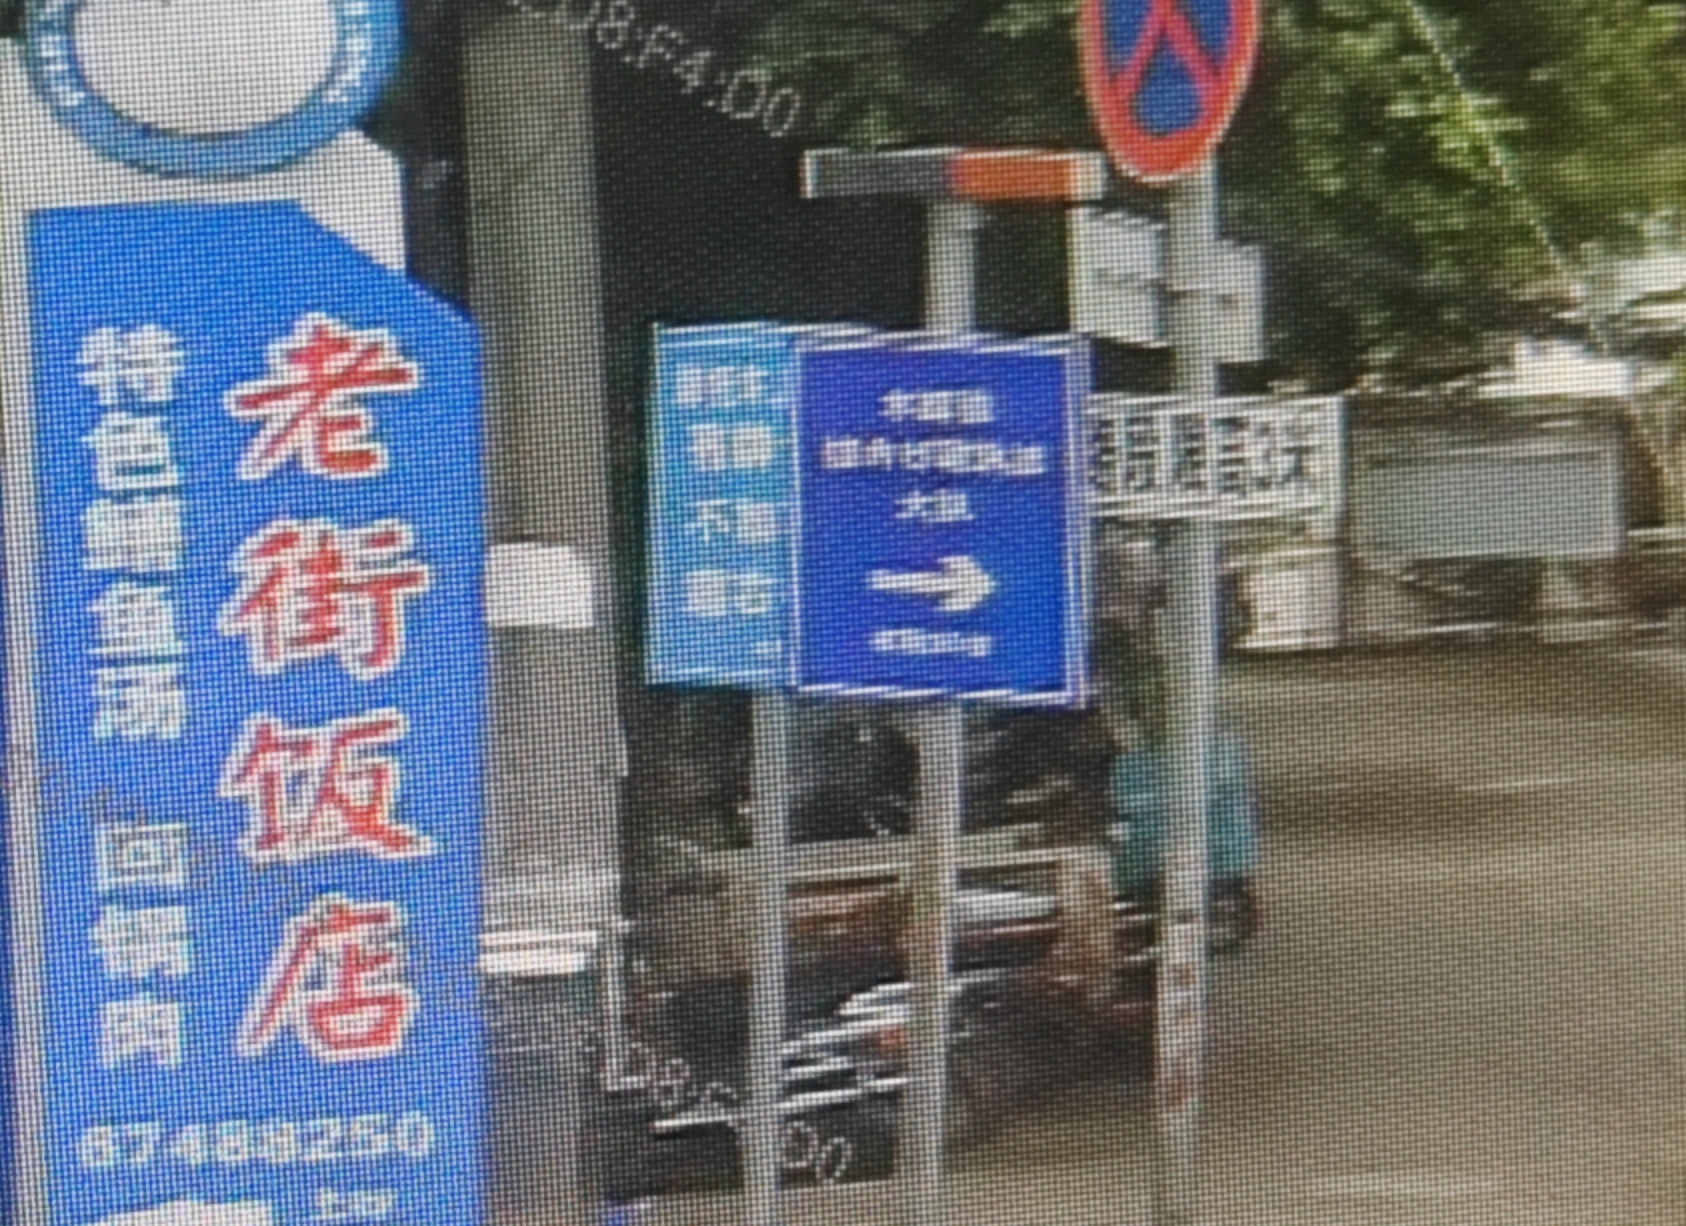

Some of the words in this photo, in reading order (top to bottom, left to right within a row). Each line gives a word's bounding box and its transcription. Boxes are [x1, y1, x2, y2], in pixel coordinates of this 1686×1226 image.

[219, 312, 438, 1064] 老街饭店
[77, 1110, 436, 1170] 67488250
